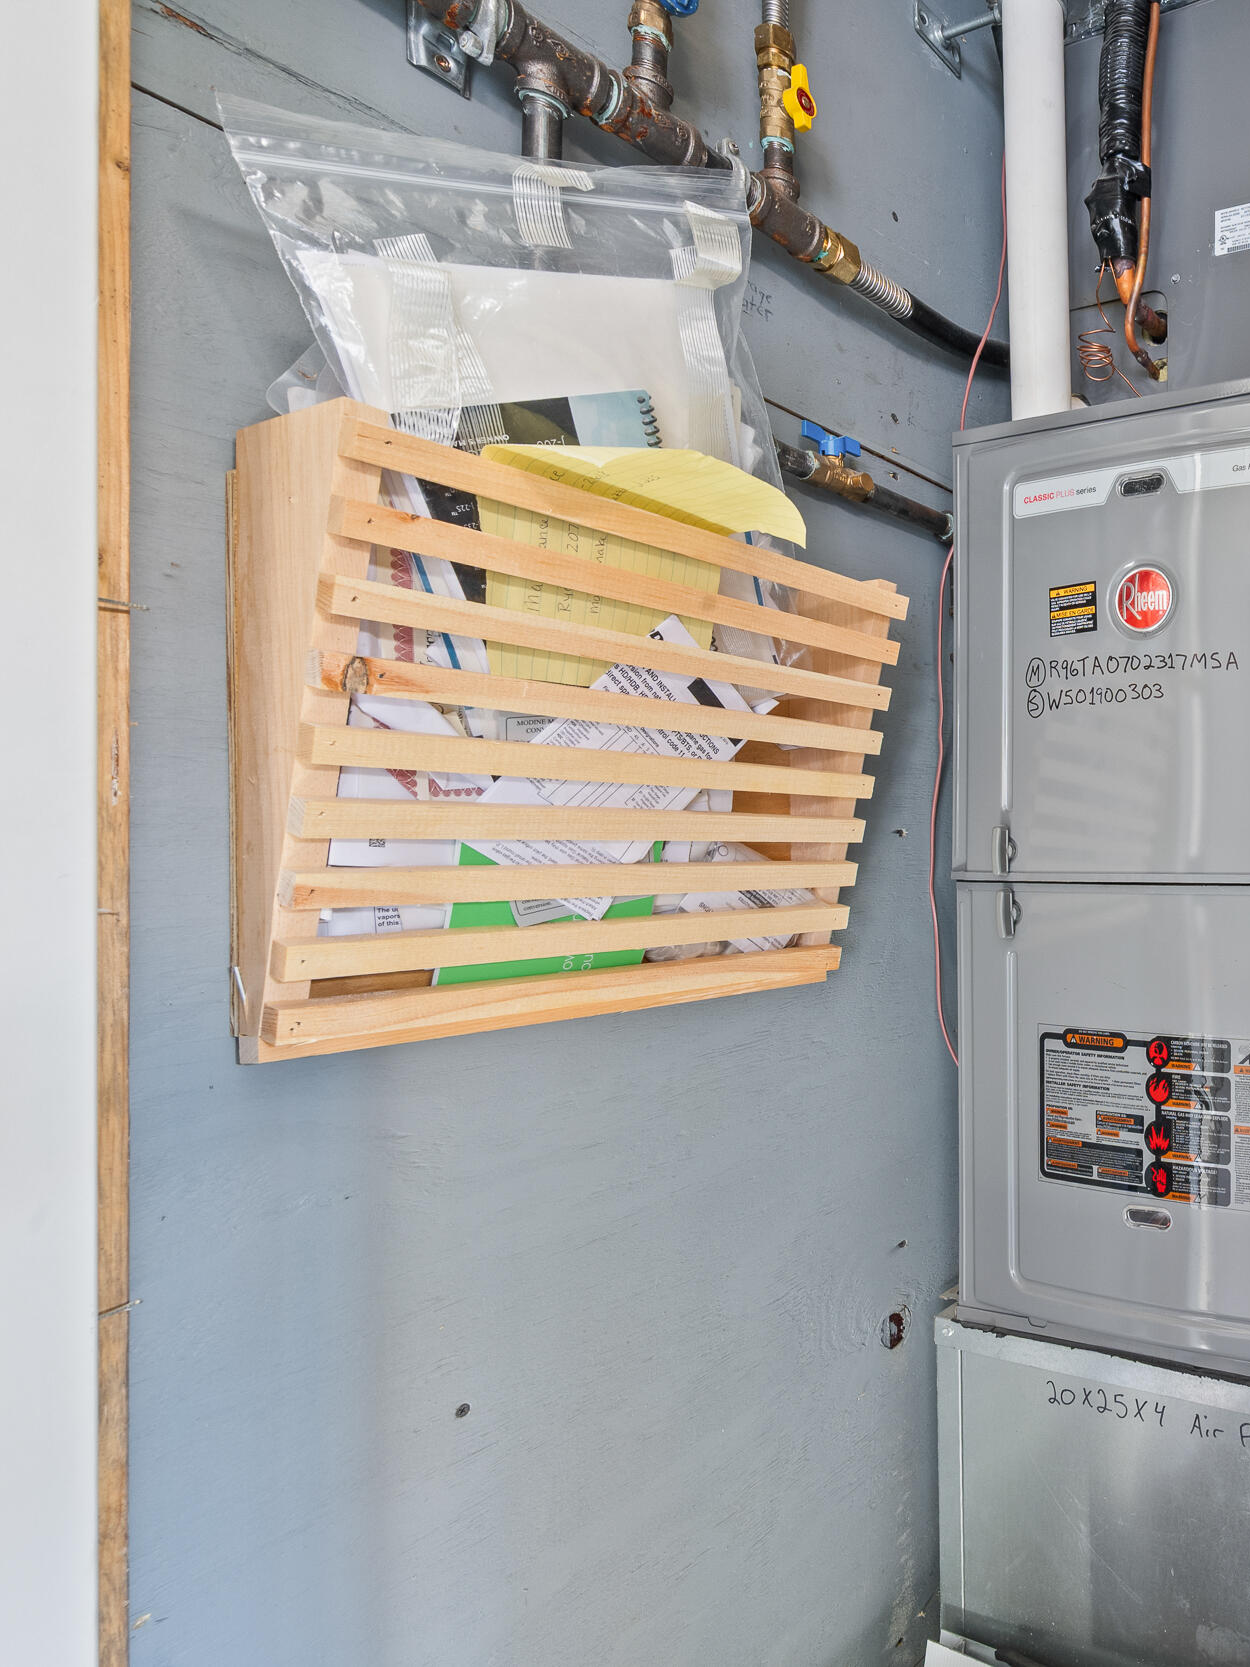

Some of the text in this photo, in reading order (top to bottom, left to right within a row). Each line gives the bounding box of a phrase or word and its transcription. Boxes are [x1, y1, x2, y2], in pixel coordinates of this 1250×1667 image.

[1232, 464, 1246, 472] Gas
[1024, 486, 1096, 504] CLASSIC PLUS series
[1122, 574, 1167, 620] Rheem
[1079, 1036, 1114, 1046] WARNING
[1190, 1414, 1224, 1439] Air
